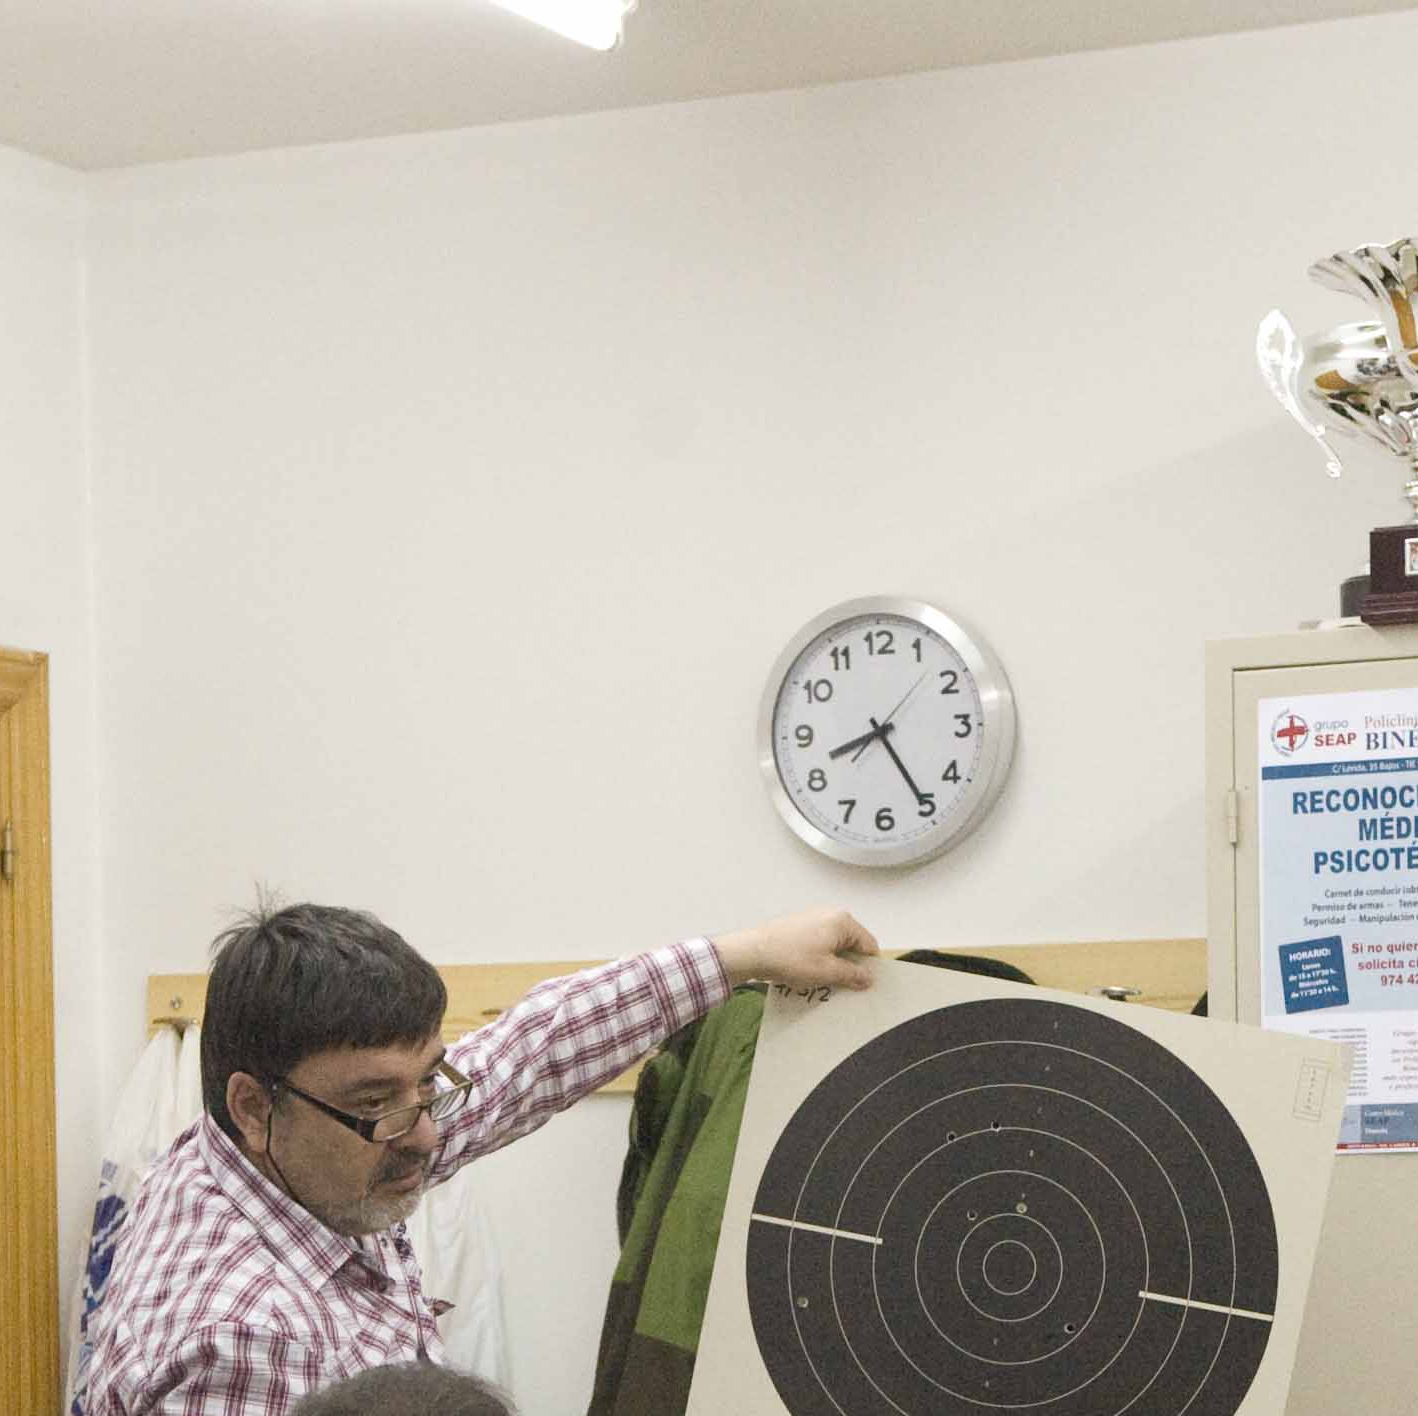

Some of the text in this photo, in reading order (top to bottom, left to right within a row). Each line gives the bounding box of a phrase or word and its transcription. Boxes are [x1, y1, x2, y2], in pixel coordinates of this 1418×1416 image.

[864, 630, 895, 656] 12
[912, 638, 922, 663] 1
[831, 645, 851, 671] 11
[803, 678, 833, 704] 10
[939, 670, 959, 695] 2
[795, 724, 814, 748] 9
[954, 713, 972, 738] 3
[1314, 718, 1349, 732] grupo
[1314, 732, 1357, 748] SEAP
[807, 768, 828, 792] 8
[942, 760, 961, 784] 4
[838, 799, 857, 824] 7
[918, 793, 937, 817] 5
[875, 807, 895, 831] 6
[1324, 887, 1353, 898] Carnet
[1353, 887, 1364, 897] de
[1365, 885, 1401, 896] conducir
[1311, 903, 1345, 912] Permiso
[1347, 902, 1357, 910] de
[1359, 902, 1384, 910] armas
[1303, 914, 1346, 927] Seguridad
[1351, 942, 1363, 954] Si
[1367, 943, 1383, 953] no
[1358, 956, 1405, 971] solicita
[1381, 974, 1404, 987] 974
